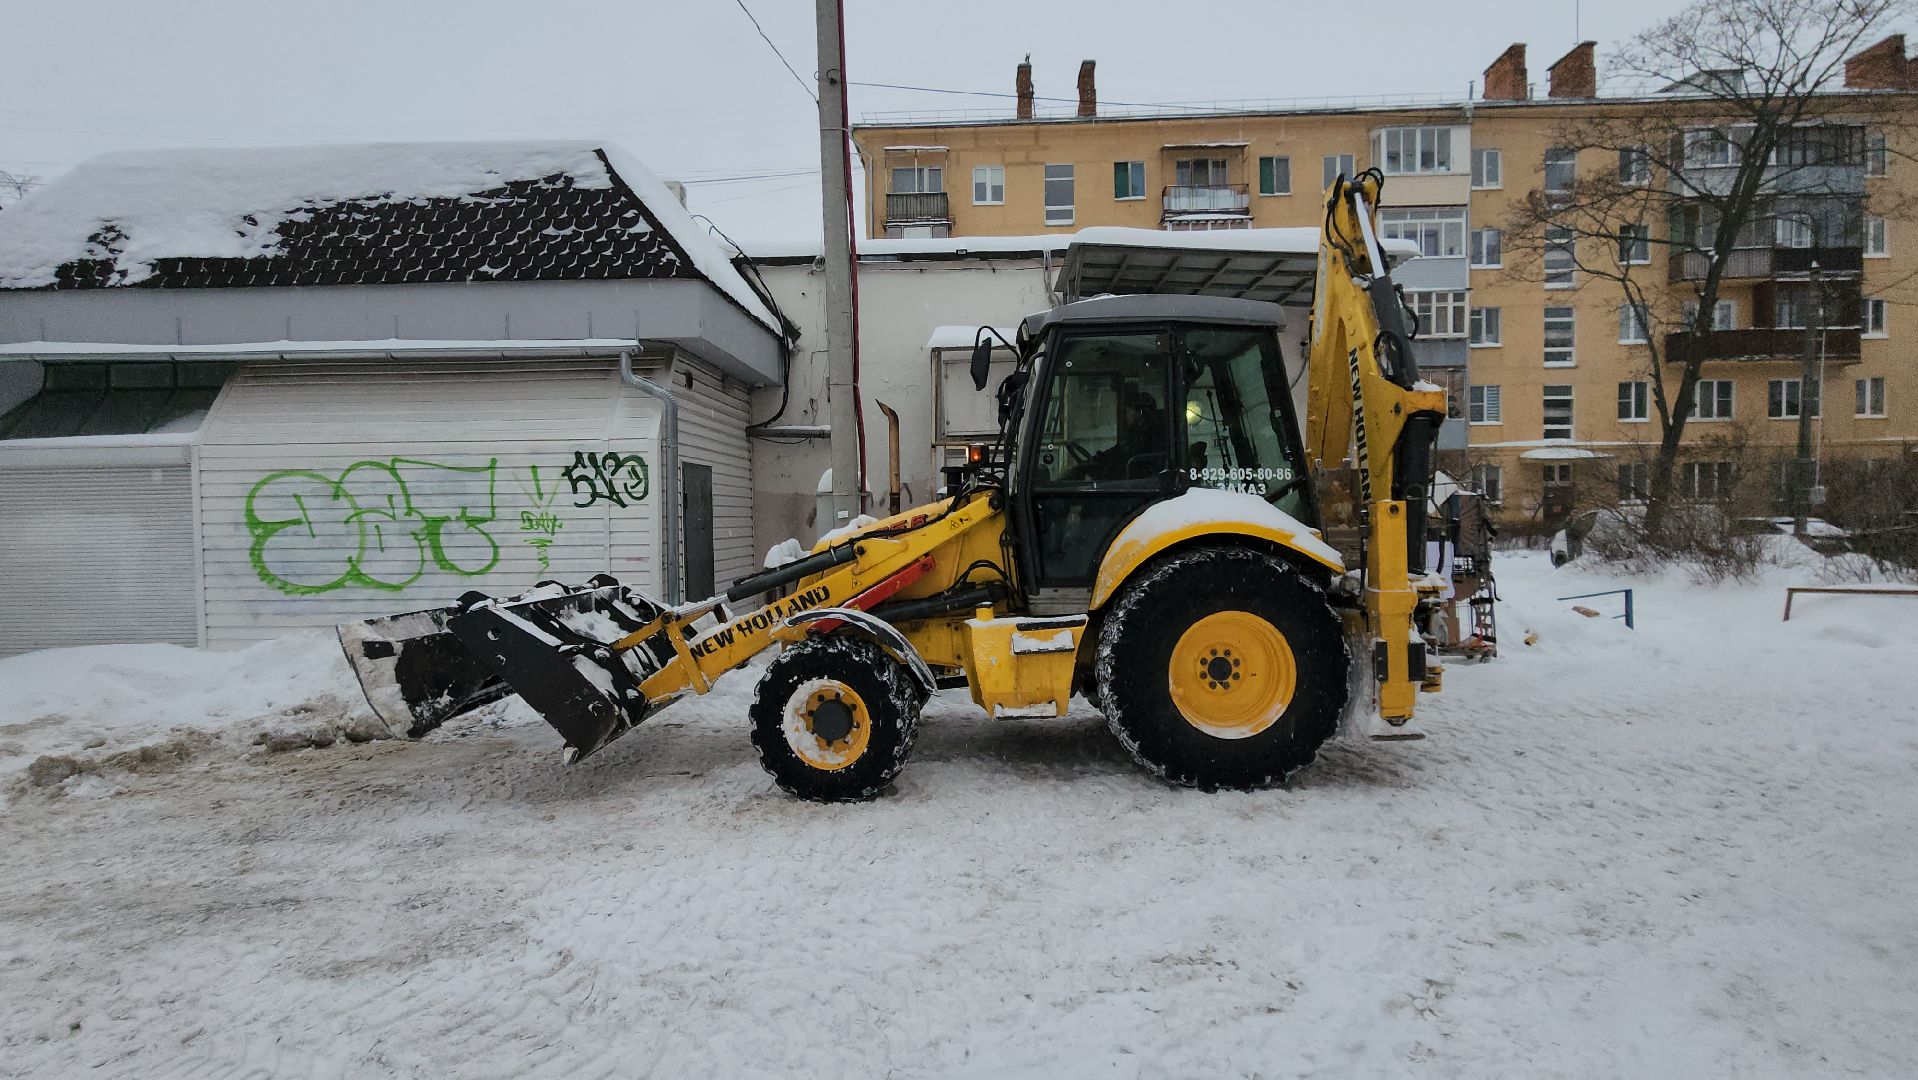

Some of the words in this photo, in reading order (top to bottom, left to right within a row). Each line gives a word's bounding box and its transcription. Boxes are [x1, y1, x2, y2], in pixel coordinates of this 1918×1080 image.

[1349, 348, 1362, 400] NEW
[1189, 467, 1292, 481] 8-929-605-80-86
[1355, 406, 1371, 505] HOLLAN
[690, 628, 735, 658] NEW
[736, 585, 831, 637] HOLLAND
